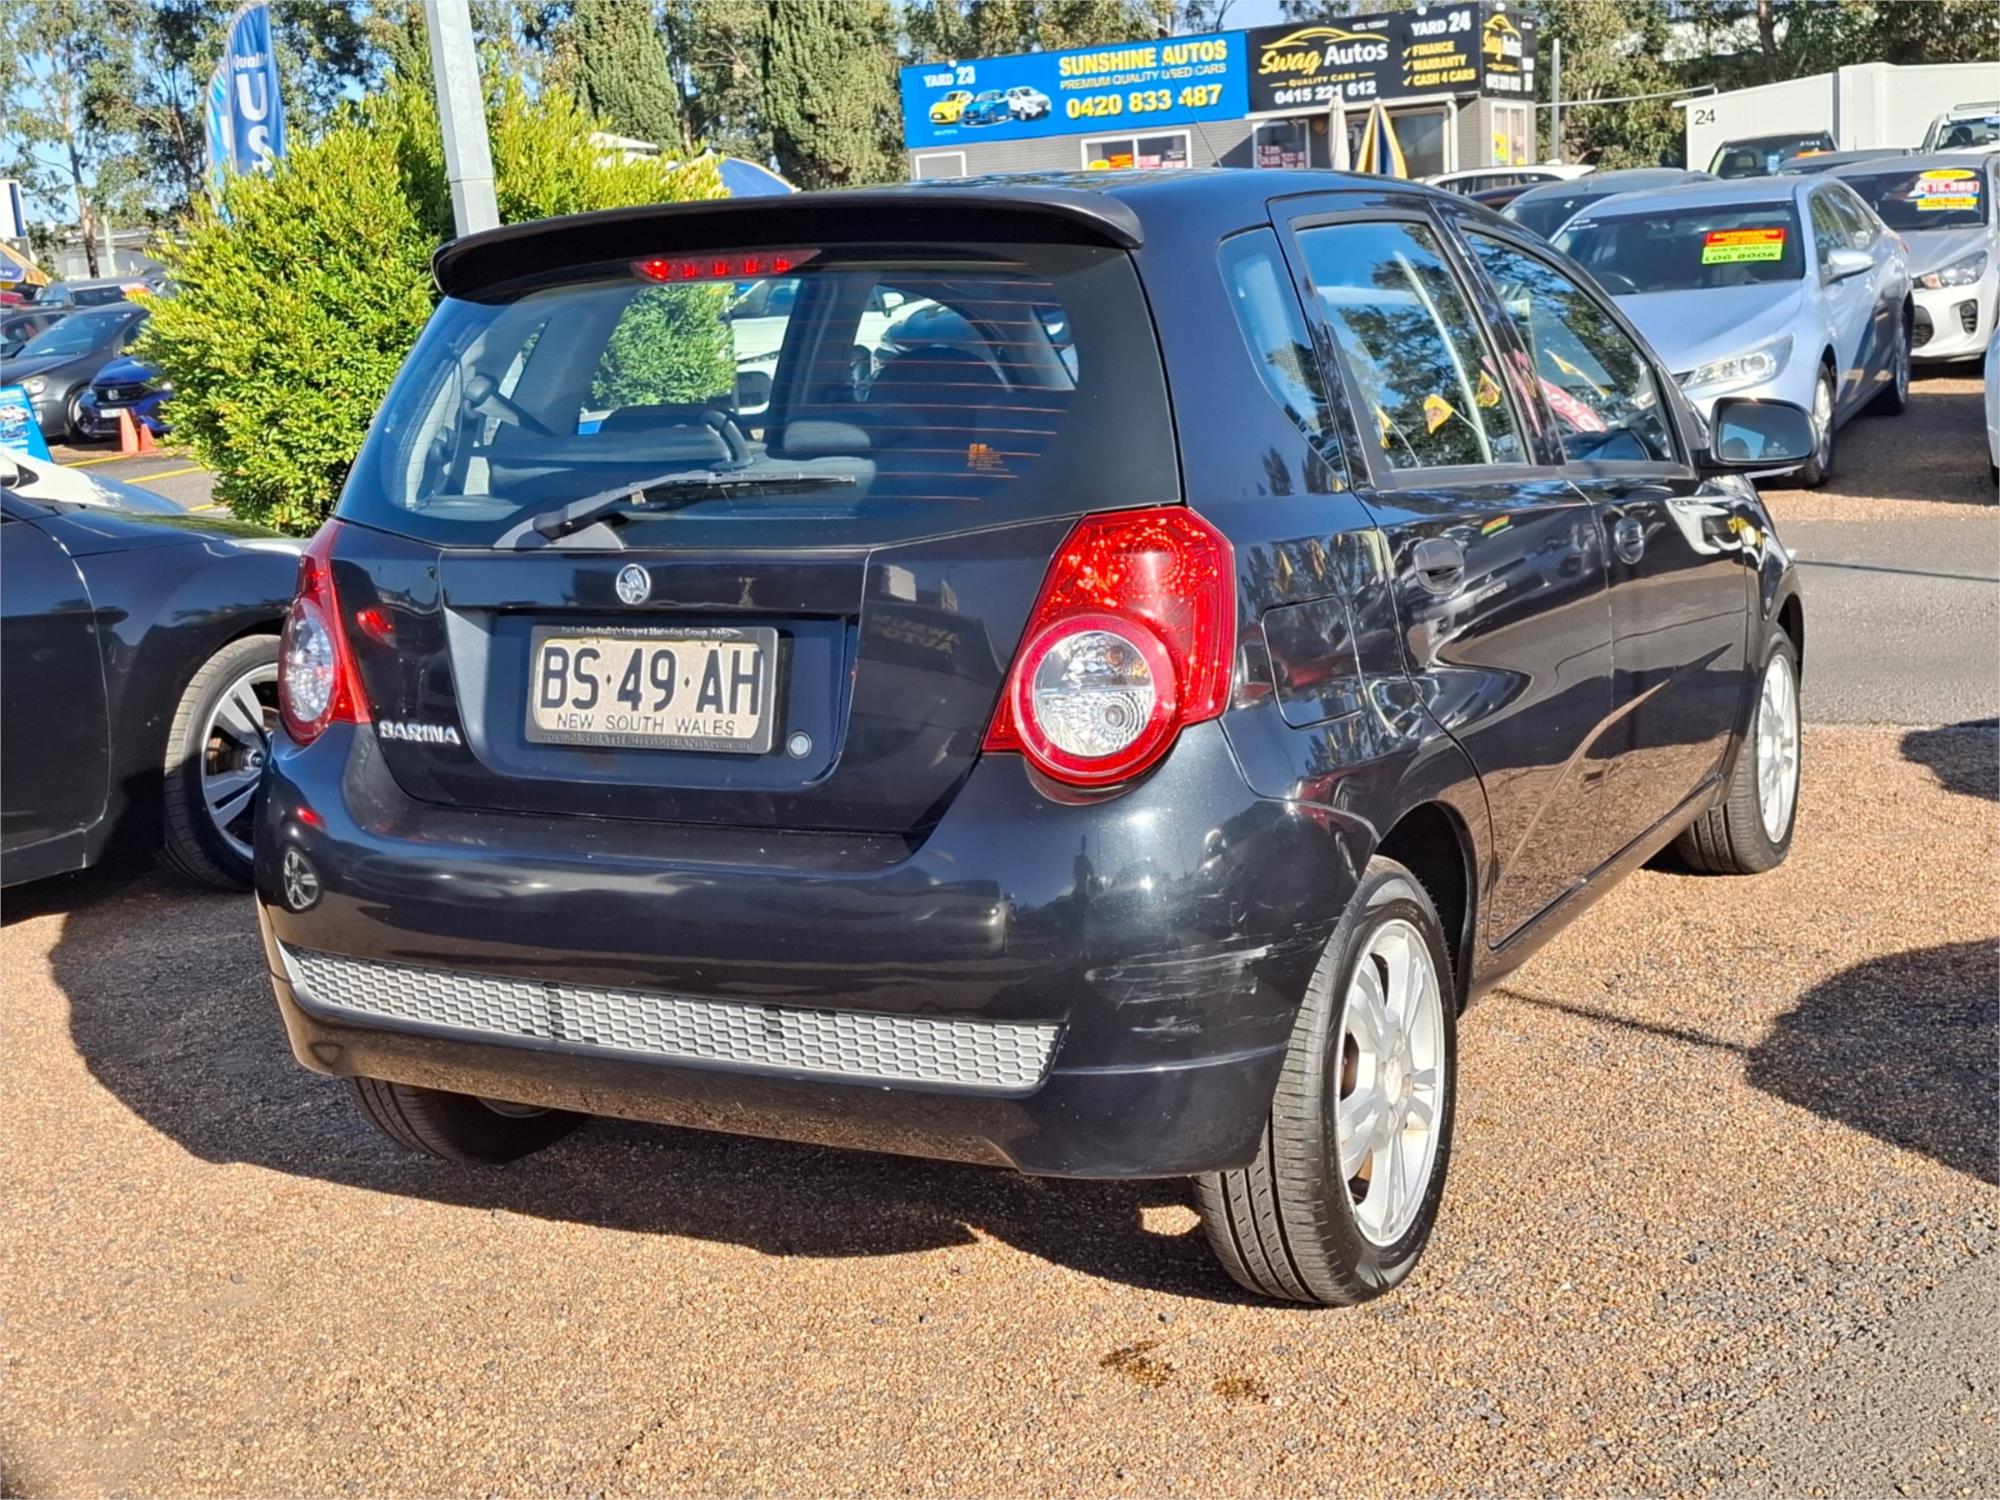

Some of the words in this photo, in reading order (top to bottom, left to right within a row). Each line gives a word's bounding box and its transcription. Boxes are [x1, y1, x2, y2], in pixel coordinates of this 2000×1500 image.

[1410, 19, 1447, 36] YARD
[1448, 10, 1471, 32] 24
[1059, 47, 1157, 76] SUNSHINE
[1161, 39, 1227, 66] AUTOS
[1258, 50, 1322, 75] Swag
[1323, 43, 1388, 66] Autos
[1412, 40, 1455, 56] FINANCE
[1412, 53, 1467, 71] WARRANTY
[923, 73, 954, 88] YARD
[956, 65, 976, 85] 23
[1060, 76, 1111, 90] PREMIUM
[1112, 70, 1159, 85] QUALITY
[1161, 66, 1193, 79] USED
[1195, 63, 1226, 76] CARS
[1288, 75, 1328, 87] QUALITY
[1330, 73, 1356, 81] CARS
[1413, 72, 1440, 86] CASH
[1441, 71, 1448, 83] 4
[1449, 68, 1476, 82] CARS
[1066, 94, 1122, 119] 0420
[1129, 89, 1172, 112] 833
[1178, 84, 1223, 107] 487
[1274, 87, 1312, 104] 0415
[1347, 80, 1377, 96] 612
[1694, 109, 1716, 125] 24
[379, 720, 461, 745] BARINA
[557, 713, 594, 729] NEW
[605, 714, 665, 733] SOUTH
[675, 718, 735, 736] WALES
